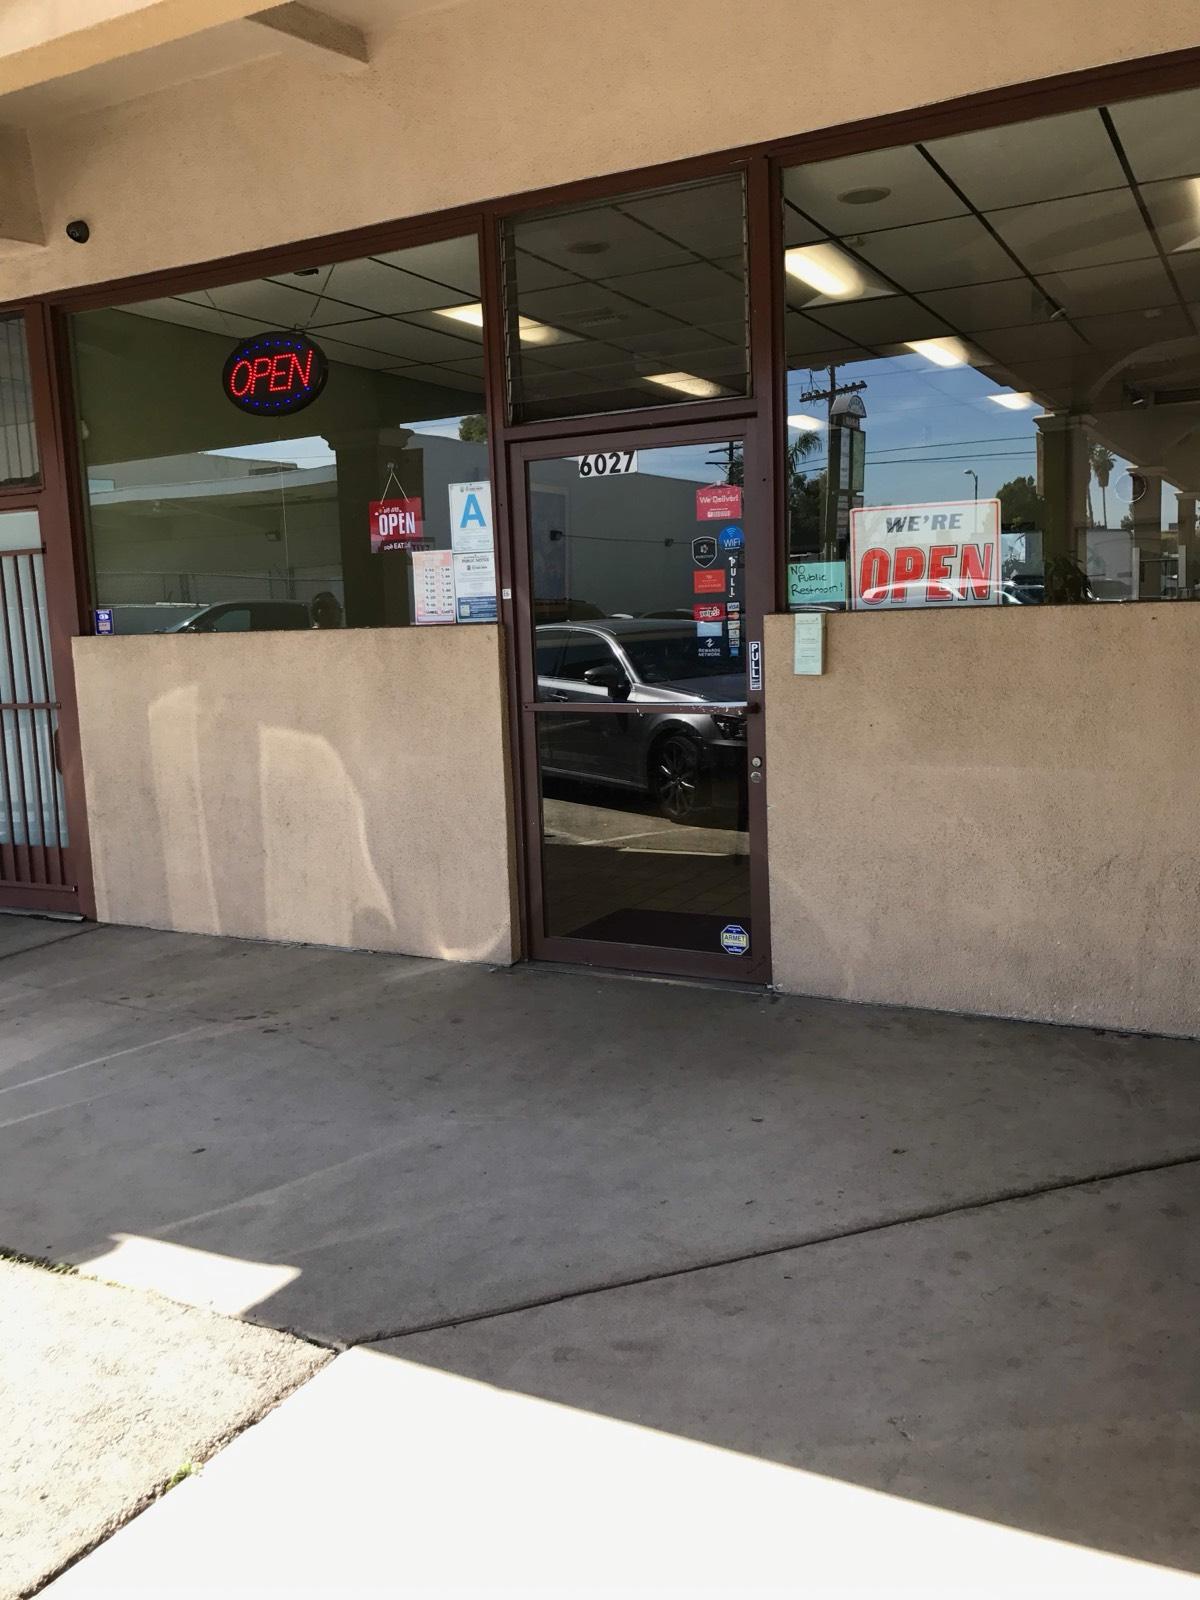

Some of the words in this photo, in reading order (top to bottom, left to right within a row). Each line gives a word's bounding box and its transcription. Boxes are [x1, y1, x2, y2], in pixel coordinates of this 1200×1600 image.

[230, 349, 314, 397] OPEN
[580, 451, 635, 476] 6027
[379, 511, 416, 535] OPEN
[460, 494, 486, 528] A
[886, 513, 963, 533] WE'RE
[729, 556, 737, 597] PULL
[797, 573, 827, 583] Public
[860, 543, 994, 605] OPEN
[751, 643, 760, 678] PULL
